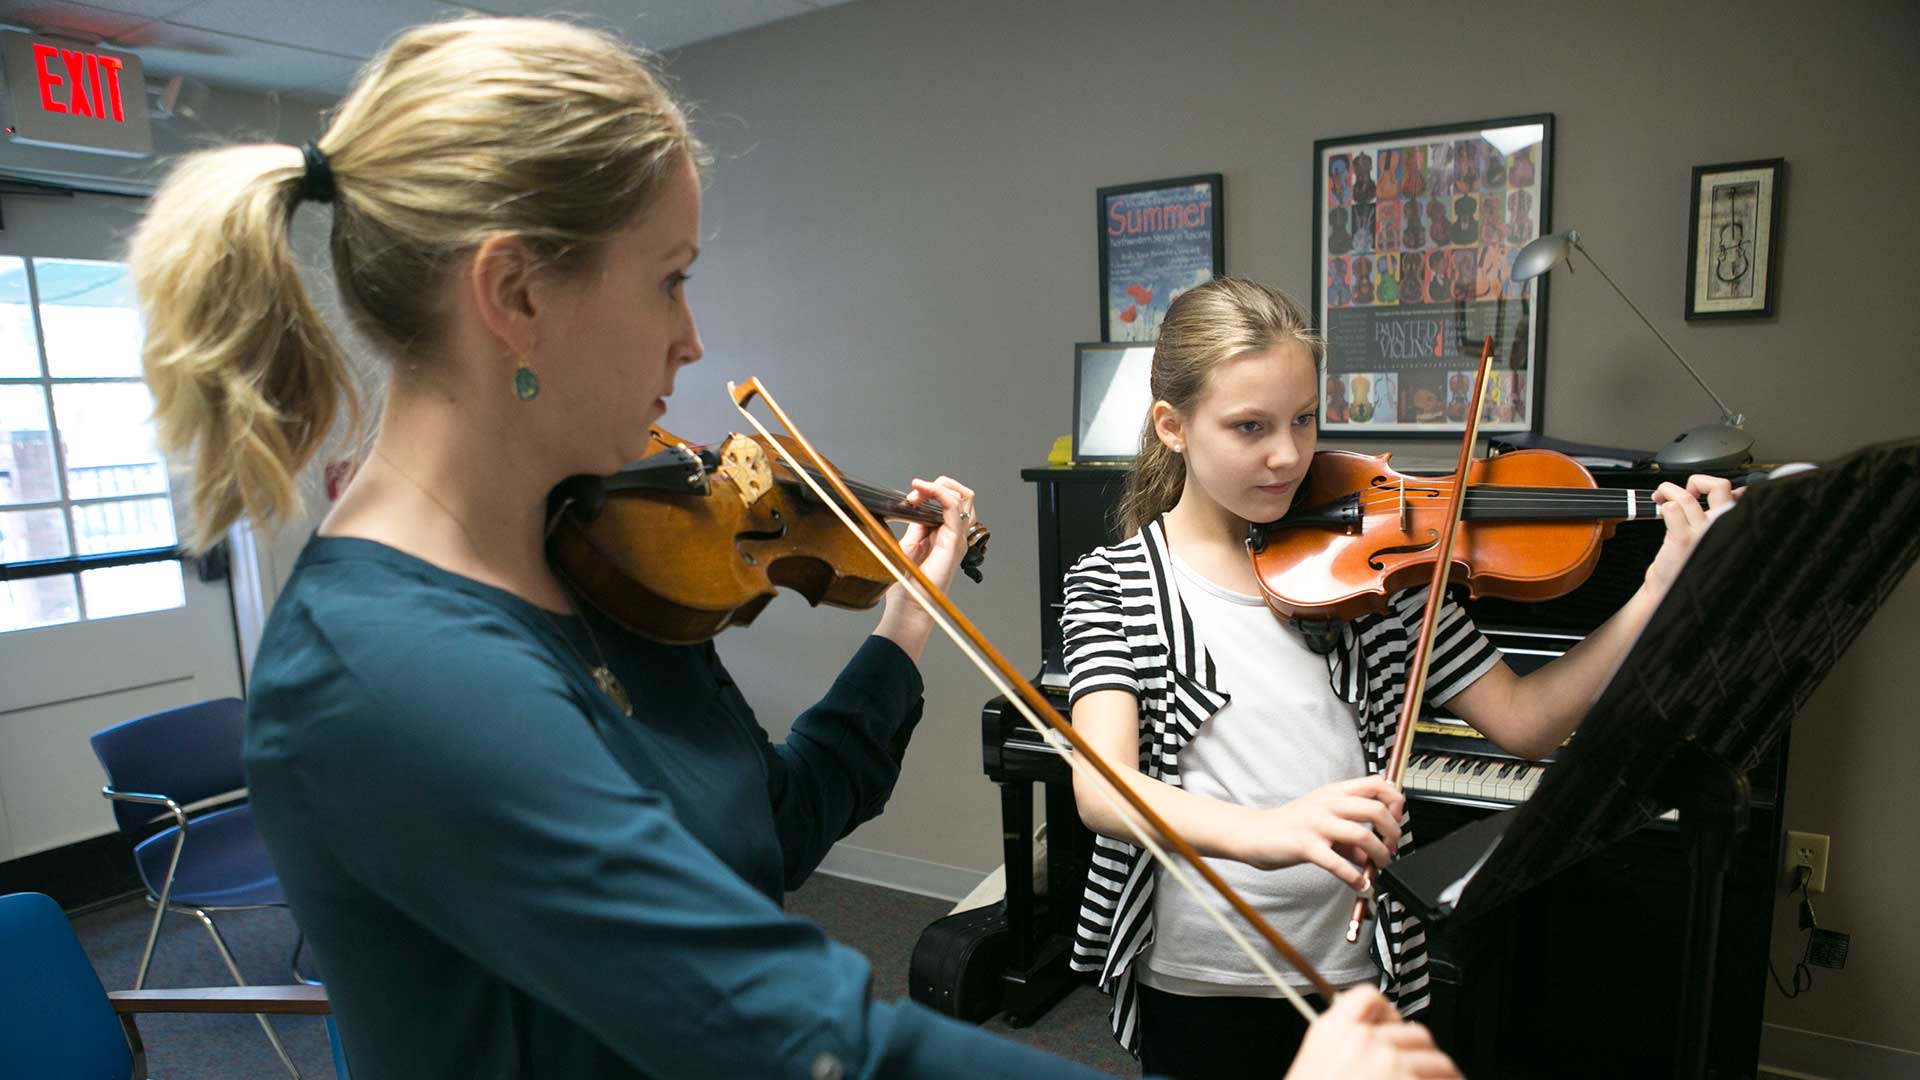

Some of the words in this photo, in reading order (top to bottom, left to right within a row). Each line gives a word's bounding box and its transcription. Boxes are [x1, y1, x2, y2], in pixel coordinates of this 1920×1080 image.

[32, 43, 125, 123] EXIT
[1108, 200, 1211, 237] Summer
[1375, 319, 1438, 341] PAINTED
[1380, 336, 1434, 358] VIOLINS
